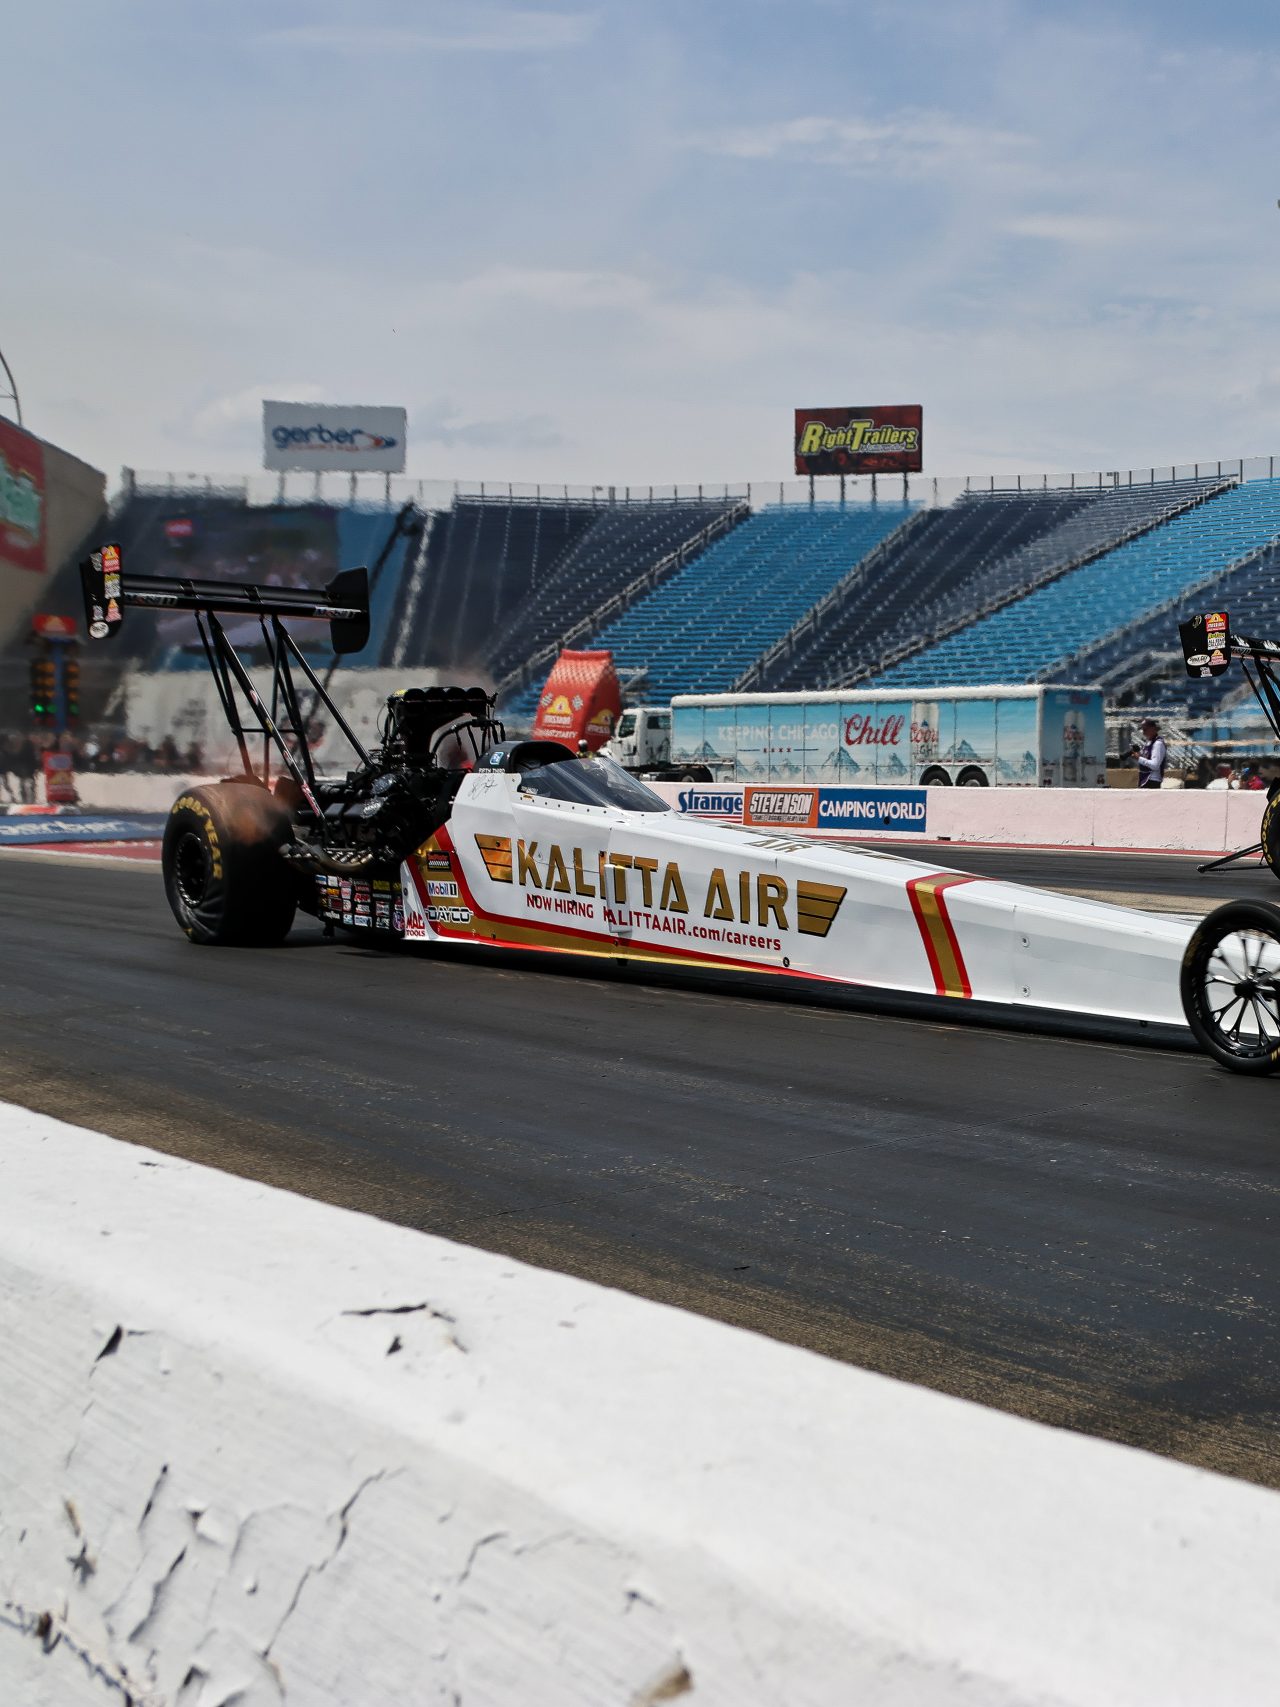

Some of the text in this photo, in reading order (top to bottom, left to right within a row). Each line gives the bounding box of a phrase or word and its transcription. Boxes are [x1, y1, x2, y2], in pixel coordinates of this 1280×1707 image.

[718, 713, 905, 746] KEEPING CHICAGO Chill
[678, 788, 743, 814] Strange
[750, 792, 814, 815] STEVENSON
[819, 800, 926, 820] CAMPING WORLD
[428, 882, 449, 895] Mobil
[516, 838, 790, 930] KALITTA AIR
[427, 905, 471, 924] DAYCO
[526, 893, 782, 951] NOW HIRING KALITTAAIR.com/careers
